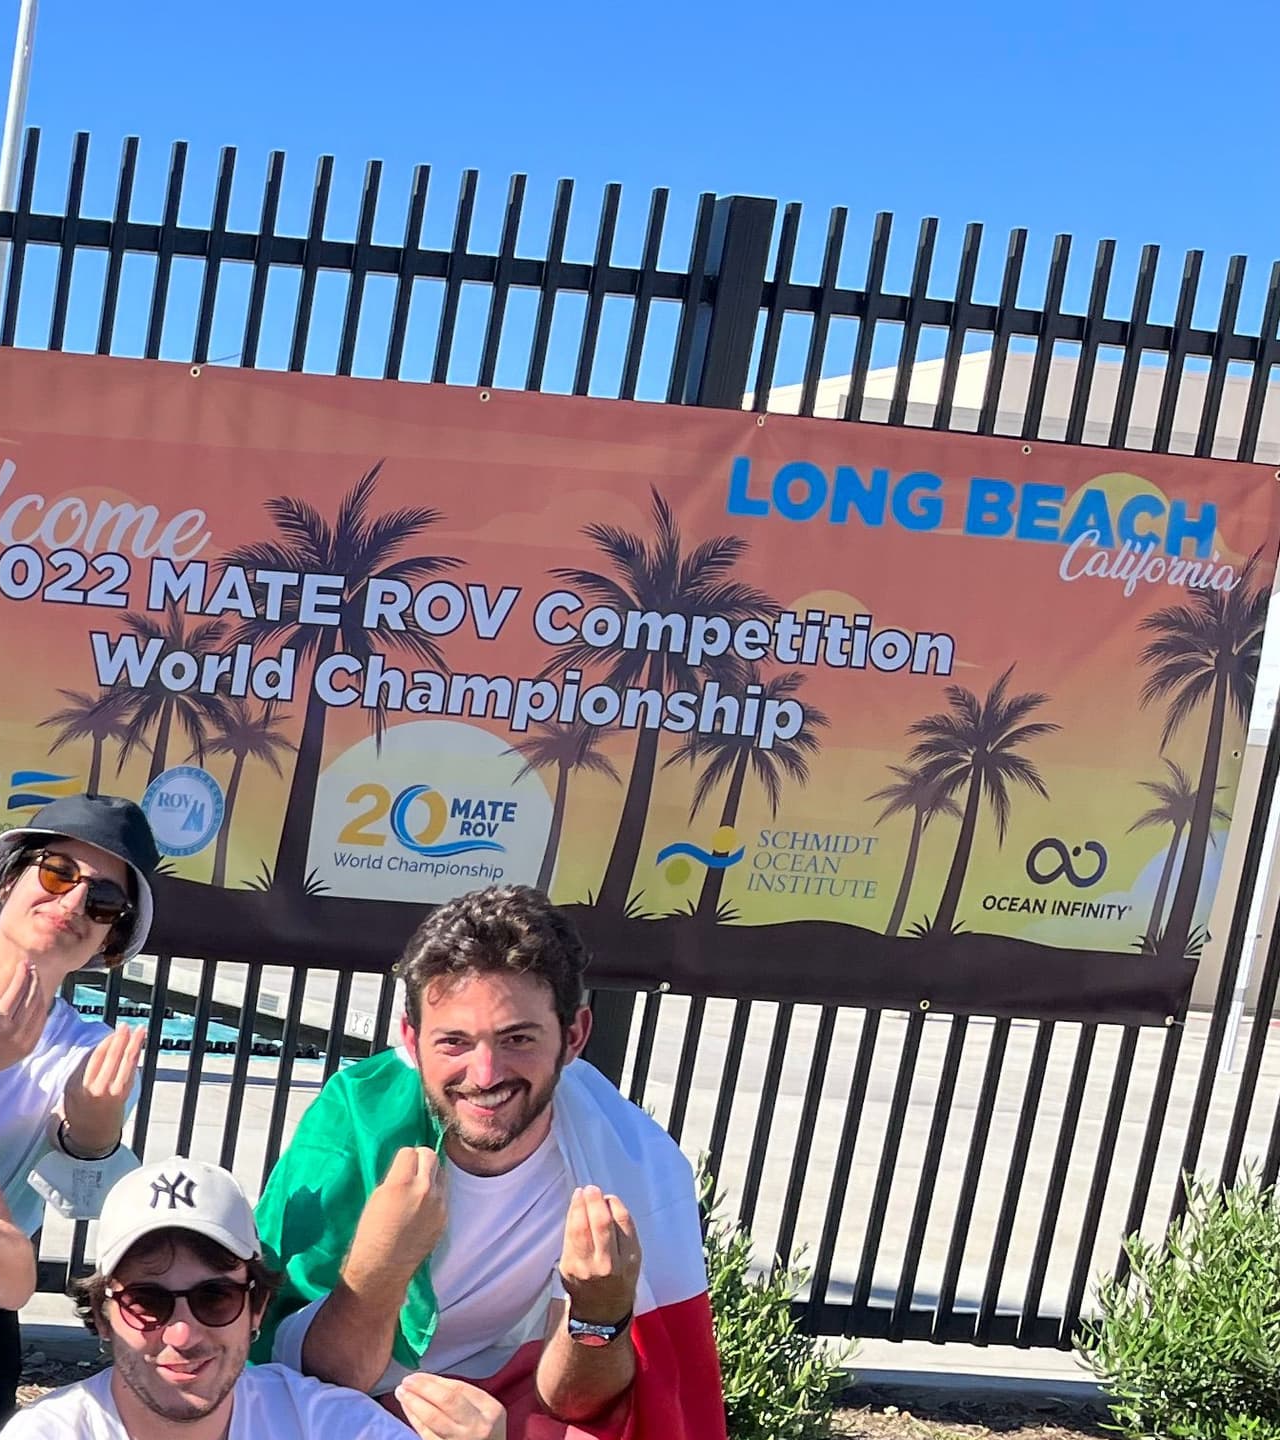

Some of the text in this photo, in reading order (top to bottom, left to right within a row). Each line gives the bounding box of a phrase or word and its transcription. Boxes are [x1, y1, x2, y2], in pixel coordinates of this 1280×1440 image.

[726, 455, 1219, 558] LONG BEACH
[1058, 528, 1242, 598] California
[147, 558, 348, 630] MATE
[361, 575, 521, 640] ROV
[532, 592, 956, 677] Competition
[90, 632, 806, 751] World Championship
[336, 782, 448, 848] 20
[450, 798, 518, 822] MATE
[459, 820, 500, 838] ROV
[756, 830, 879, 857] SCHMIDT
[334, 851, 505, 881] World Championship
[752, 851, 843, 875] OCEAN
[746, 872, 878, 899] INSTITUTE
[982, 894, 1047, 915] OCEAN
[149, 1170, 198, 1209] NY
